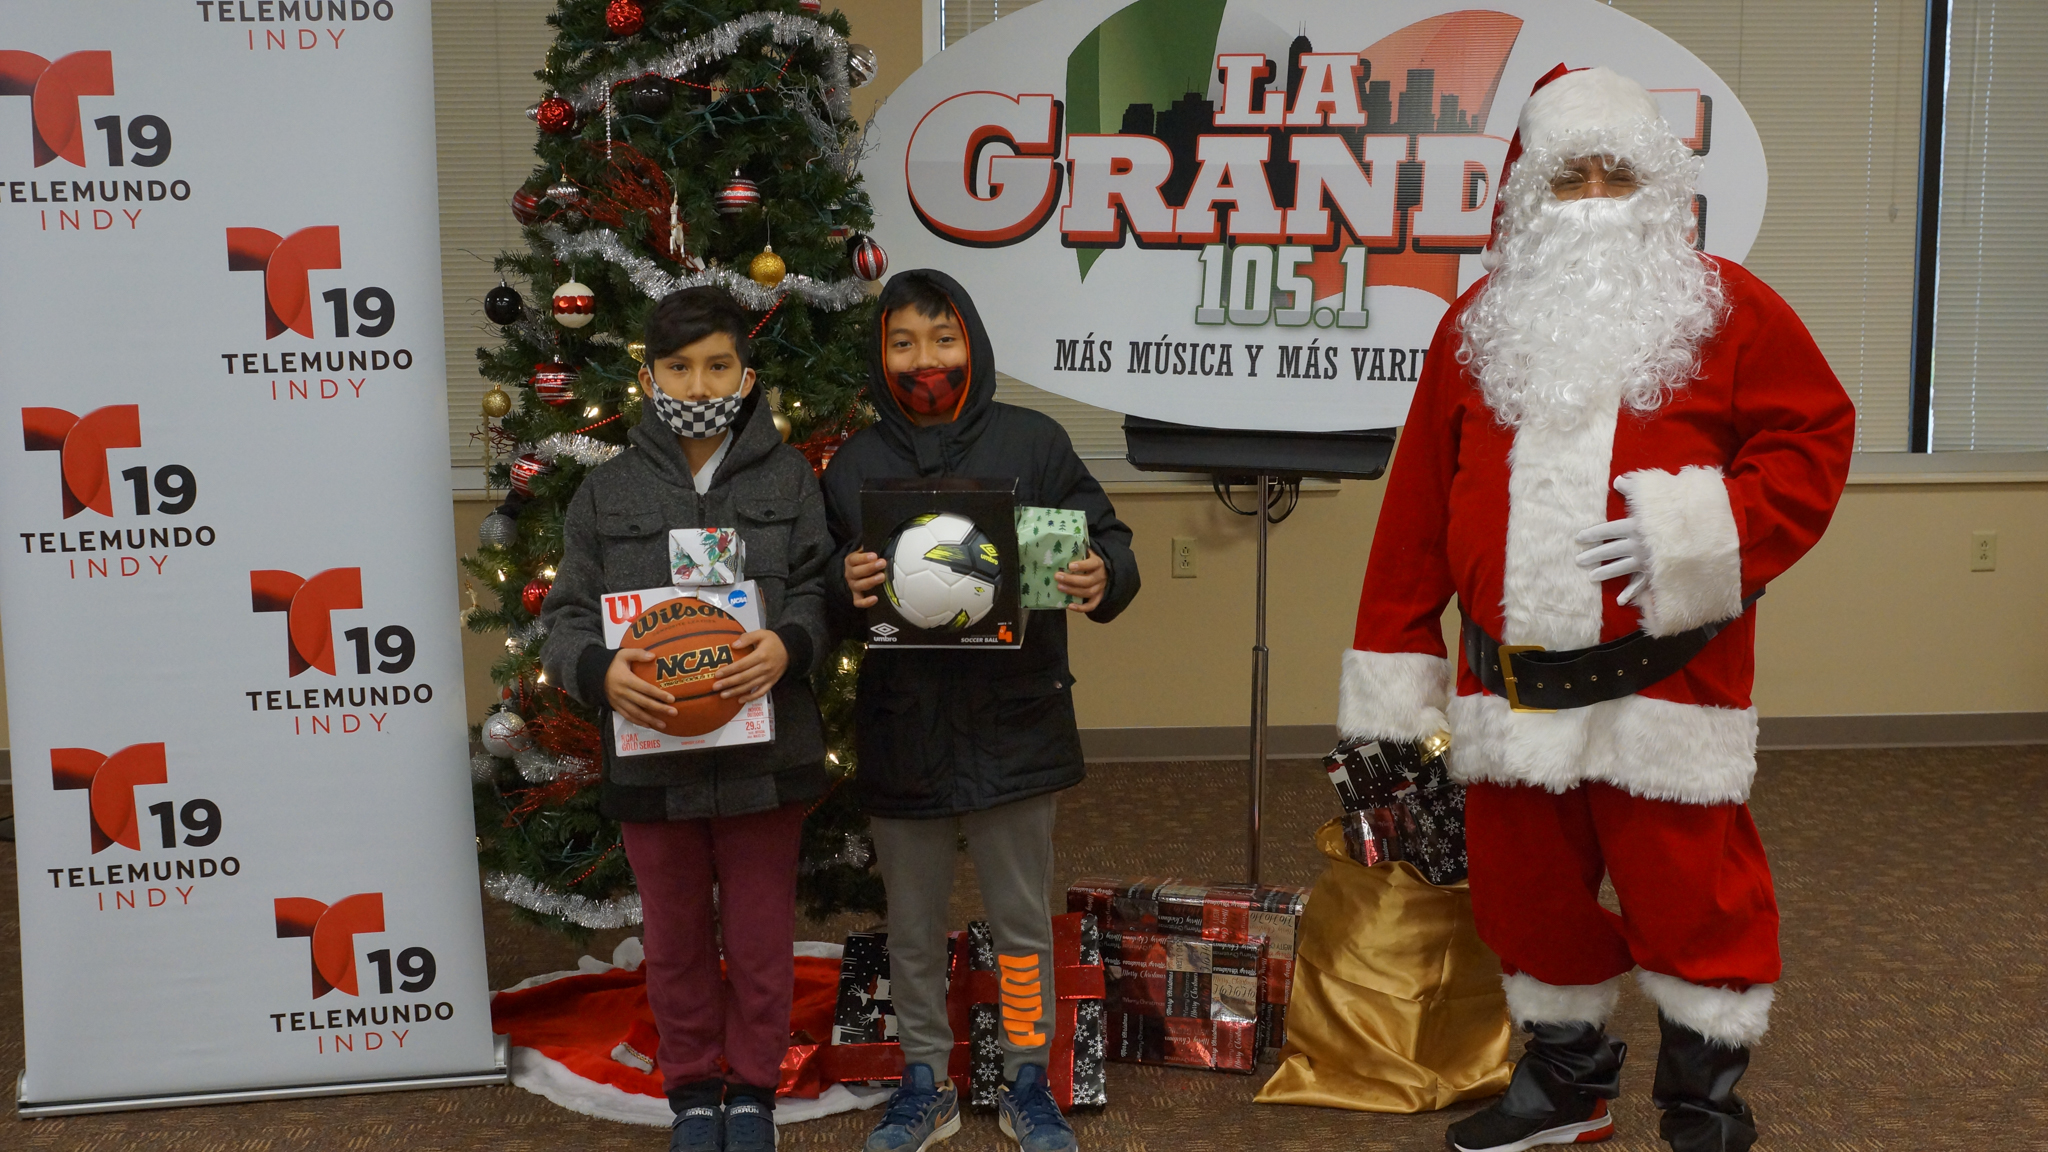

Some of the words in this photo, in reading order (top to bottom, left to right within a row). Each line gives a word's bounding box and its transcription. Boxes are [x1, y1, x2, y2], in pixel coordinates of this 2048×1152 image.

[196, 0, 394, 22] TELEMUNDO
[248, 28, 346, 51] INDY
[1213, 53, 1368, 127] LA
[95, 116, 172, 168] 19
[906, 90, 1711, 255] GRAND
[41, 208, 142, 231] INDY
[1195, 243, 1369, 329] 105.1
[323, 287, 396, 338] 19
[221, 349, 413, 375] TELEMUNDO
[1054, 332, 1113, 373] MÁS
[1127, 334, 1234, 377] MÚSICA
[1245, 344, 1264, 377] Y
[1276, 338, 1338, 380] MÁS
[1351, 347, 1429, 382] VARI
[271, 379, 366, 401] INDY
[121, 465, 197, 516] 19
[20, 526, 216, 554] TELEMUNDO
[70, 555, 168, 580] INDY
[344, 625, 416, 675] 19
[656, 644, 734, 682] NCAA
[246, 684, 433, 712] TELEMUNDO
[294, 713, 388, 736] INDY
[745, 720, 765, 731] 29.5"
[639, 739, 661, 750] SERIES
[148, 799, 222, 849] 19
[48, 857, 241, 889] TELEMUNDO
[98, 886, 194, 912] INDY
[366, 947, 437, 995] 19
[1122, 969, 1139, 979] Merry
[1139, 970, 1167, 979] Christmas
[270, 1002, 454, 1034] TELEMUNDO
[318, 1030, 410, 1055] INDY
